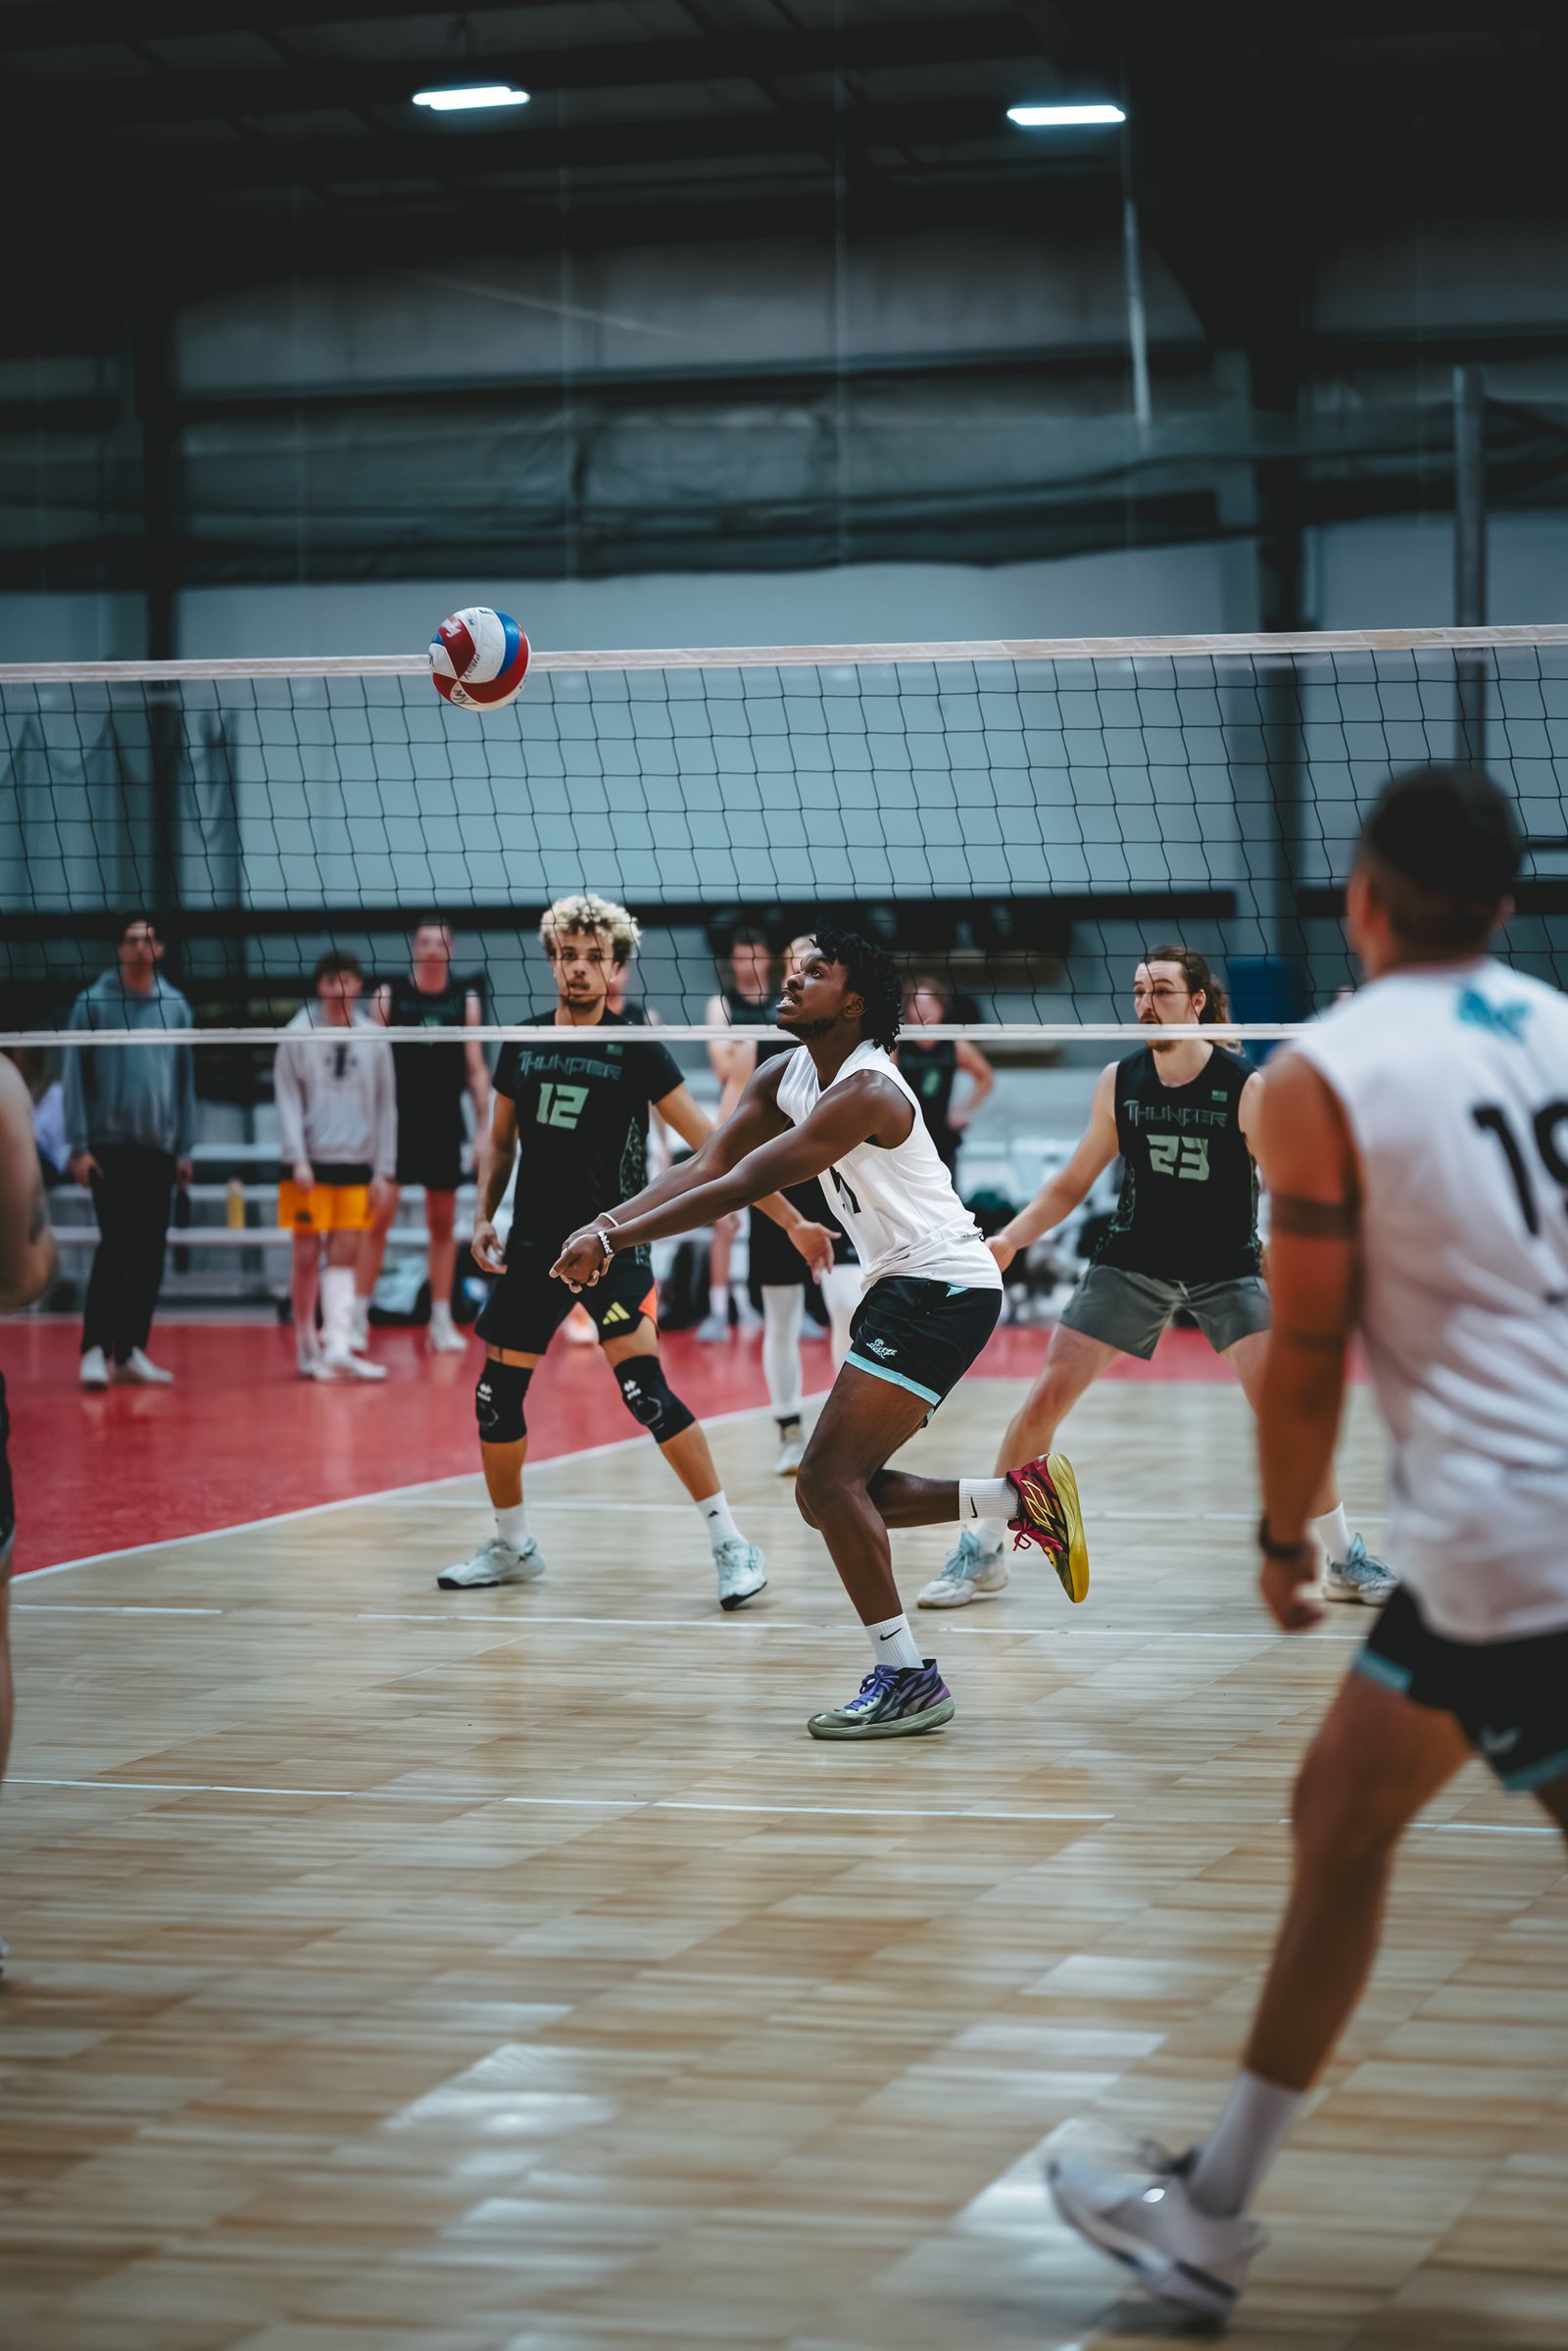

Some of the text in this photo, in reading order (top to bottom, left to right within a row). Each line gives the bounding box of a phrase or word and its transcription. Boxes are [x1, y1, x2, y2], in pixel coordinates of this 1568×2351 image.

[518, 1051, 622, 1080] THUNDER
[536, 1082, 590, 1129] 12
[1123, 1099, 1228, 1127] THUNDER
[1146, 1134, 1210, 1181] 23
